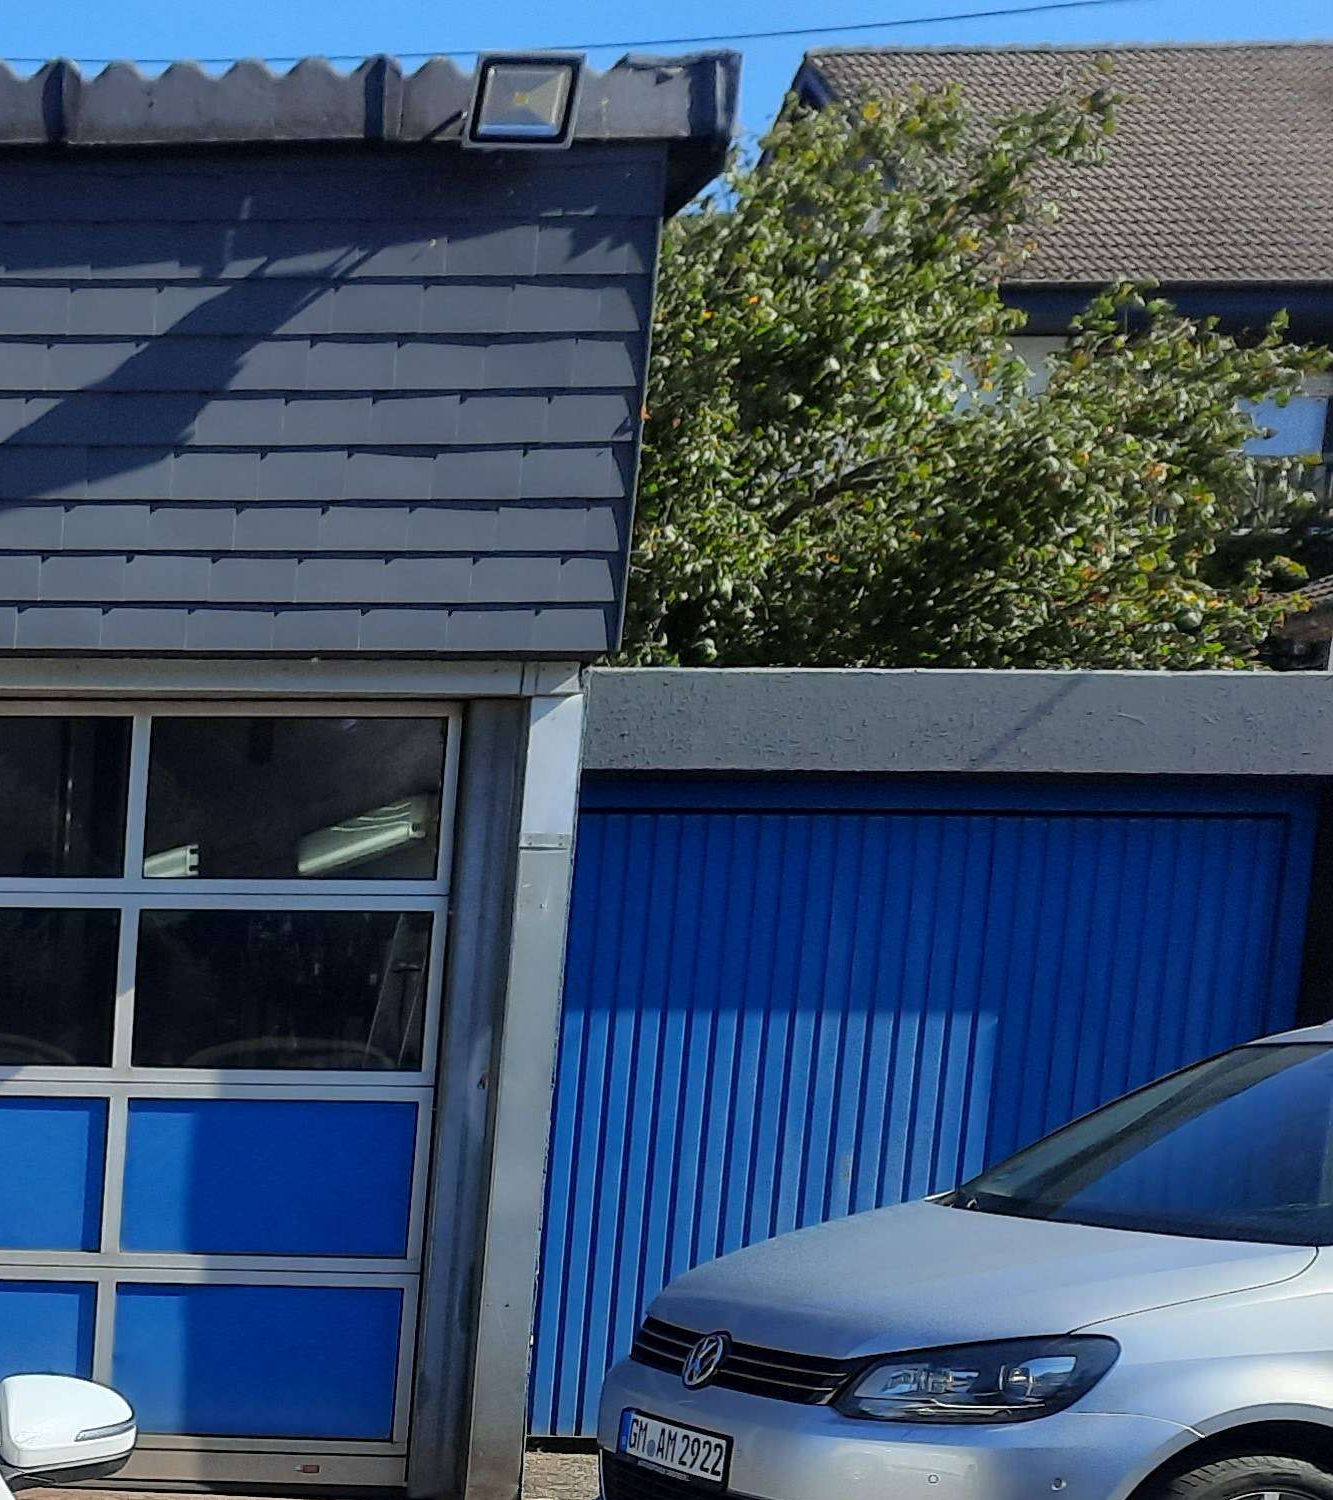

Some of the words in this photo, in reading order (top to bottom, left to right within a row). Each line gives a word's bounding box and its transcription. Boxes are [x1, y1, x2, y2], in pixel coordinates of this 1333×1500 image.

[628, 1418, 648, 1453] GM
[656, 1427, 677, 1462] AM
[678, 1433, 723, 1477] 2922
